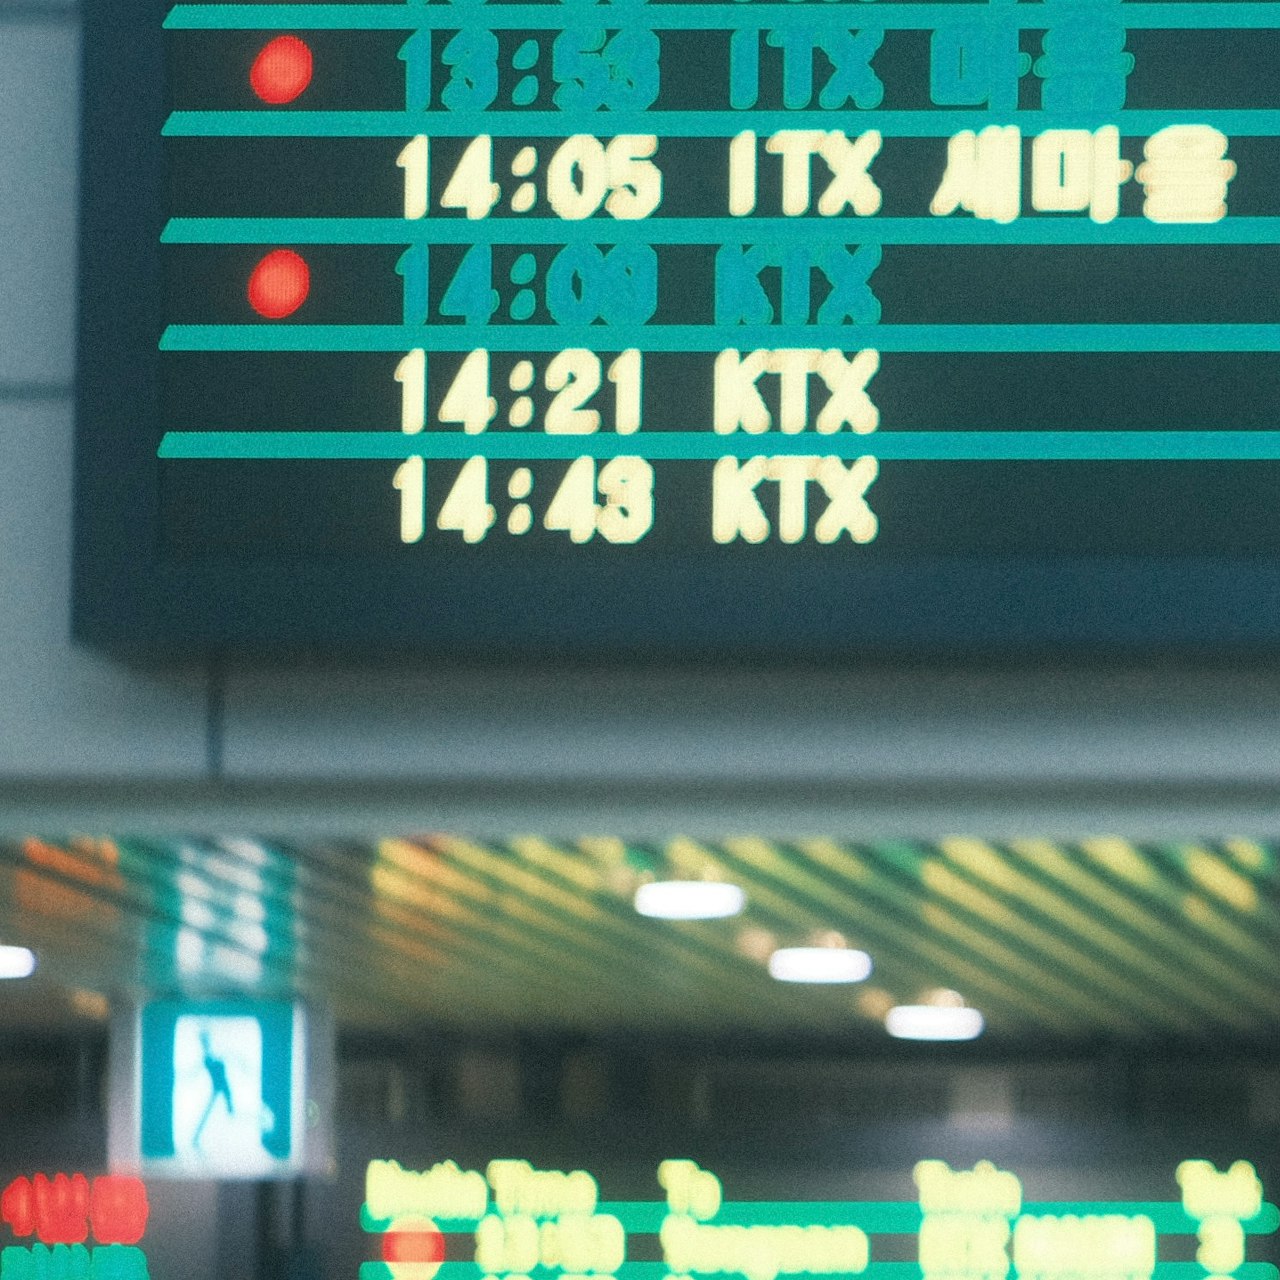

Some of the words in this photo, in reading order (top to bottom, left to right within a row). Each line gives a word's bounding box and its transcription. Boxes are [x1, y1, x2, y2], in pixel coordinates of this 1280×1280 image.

[729, 22, 884, 110] ITX
[397, 134, 662, 219] 14:05
[729, 130, 882, 216] ITX
[714, 241, 882, 326] KTX
[394, 349, 642, 434] 14:21
[713, 349, 880, 434] KTX
[393, 456, 654, 543] 14:43
[712, 455, 879, 543] KTX
